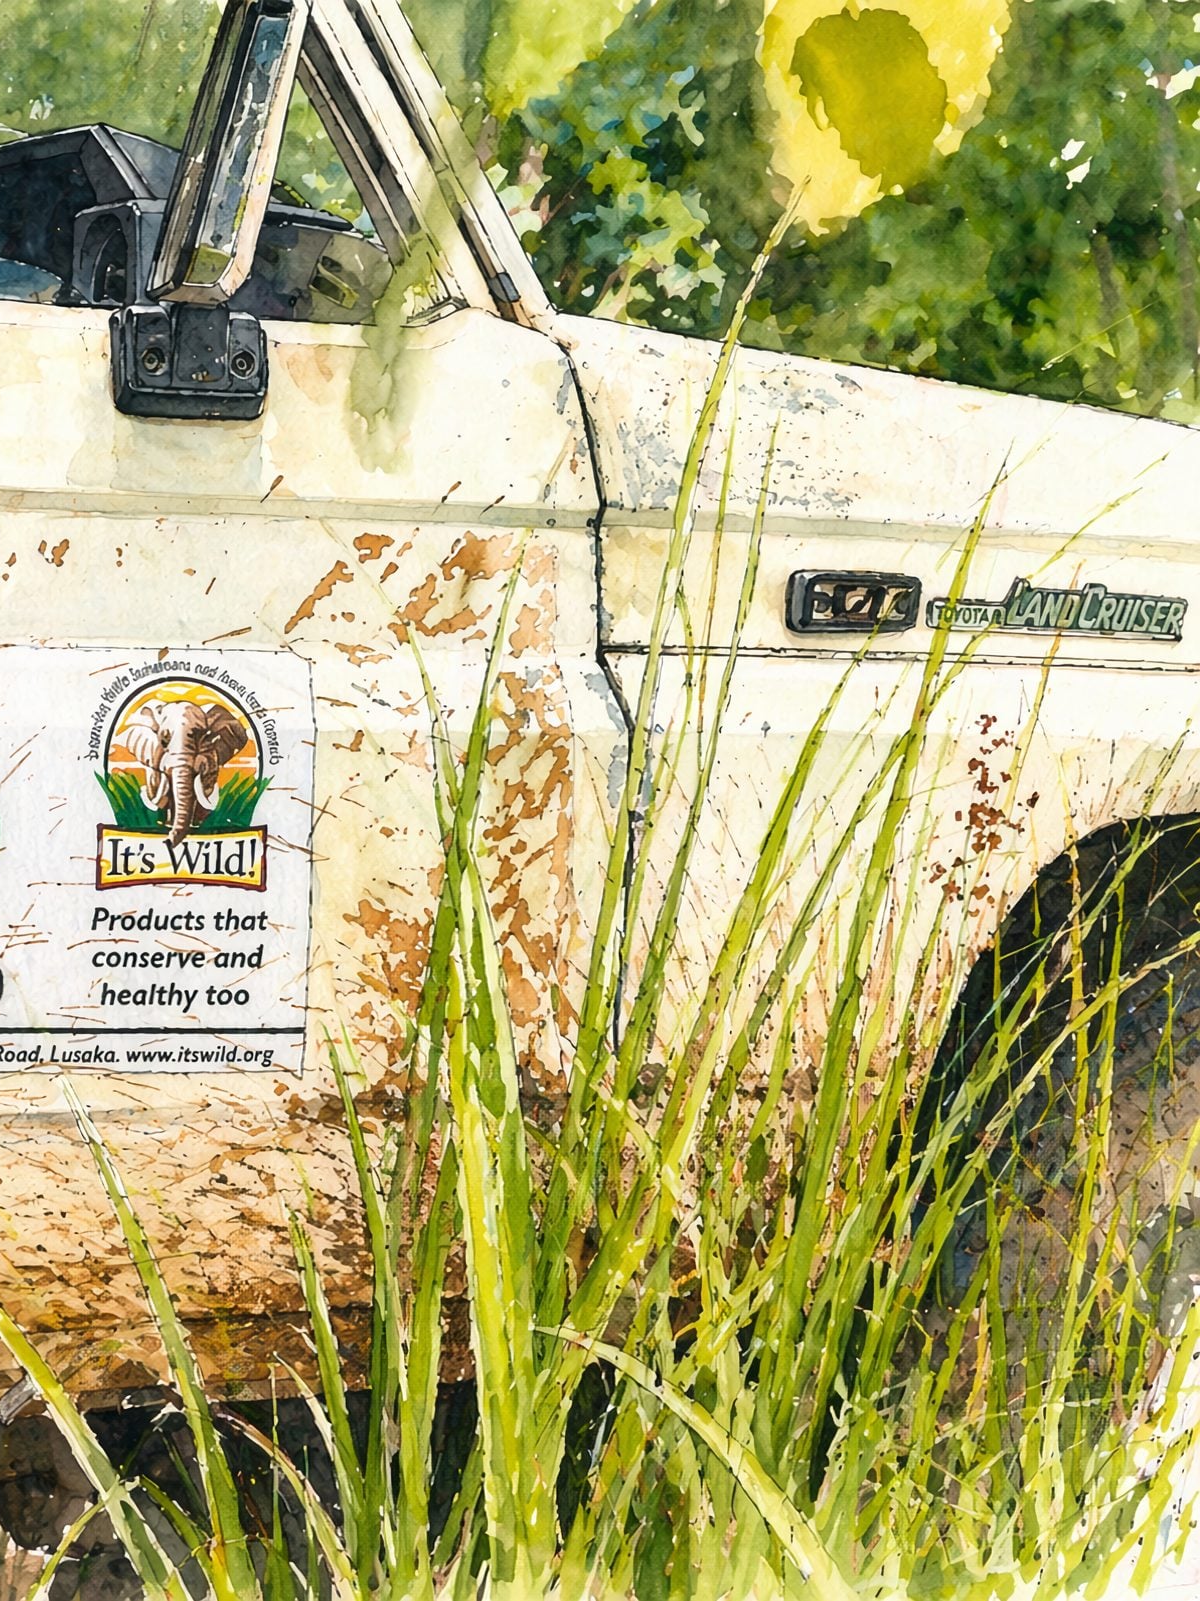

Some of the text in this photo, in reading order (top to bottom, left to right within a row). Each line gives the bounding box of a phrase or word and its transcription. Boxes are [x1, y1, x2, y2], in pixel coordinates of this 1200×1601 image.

[1005, 581, 1080, 627] LAND
[1078, 583, 1184, 636] CRUISER
[166, 838, 257, 878] Wild!
[91, 907, 268, 932] Products that
[92, 944, 264, 969] conserve and
[100, 982, 250, 1013] healthy too
[50, 1044, 120, 1063] Lusaka.
[126, 1045, 274, 1066] www.itswild.org
